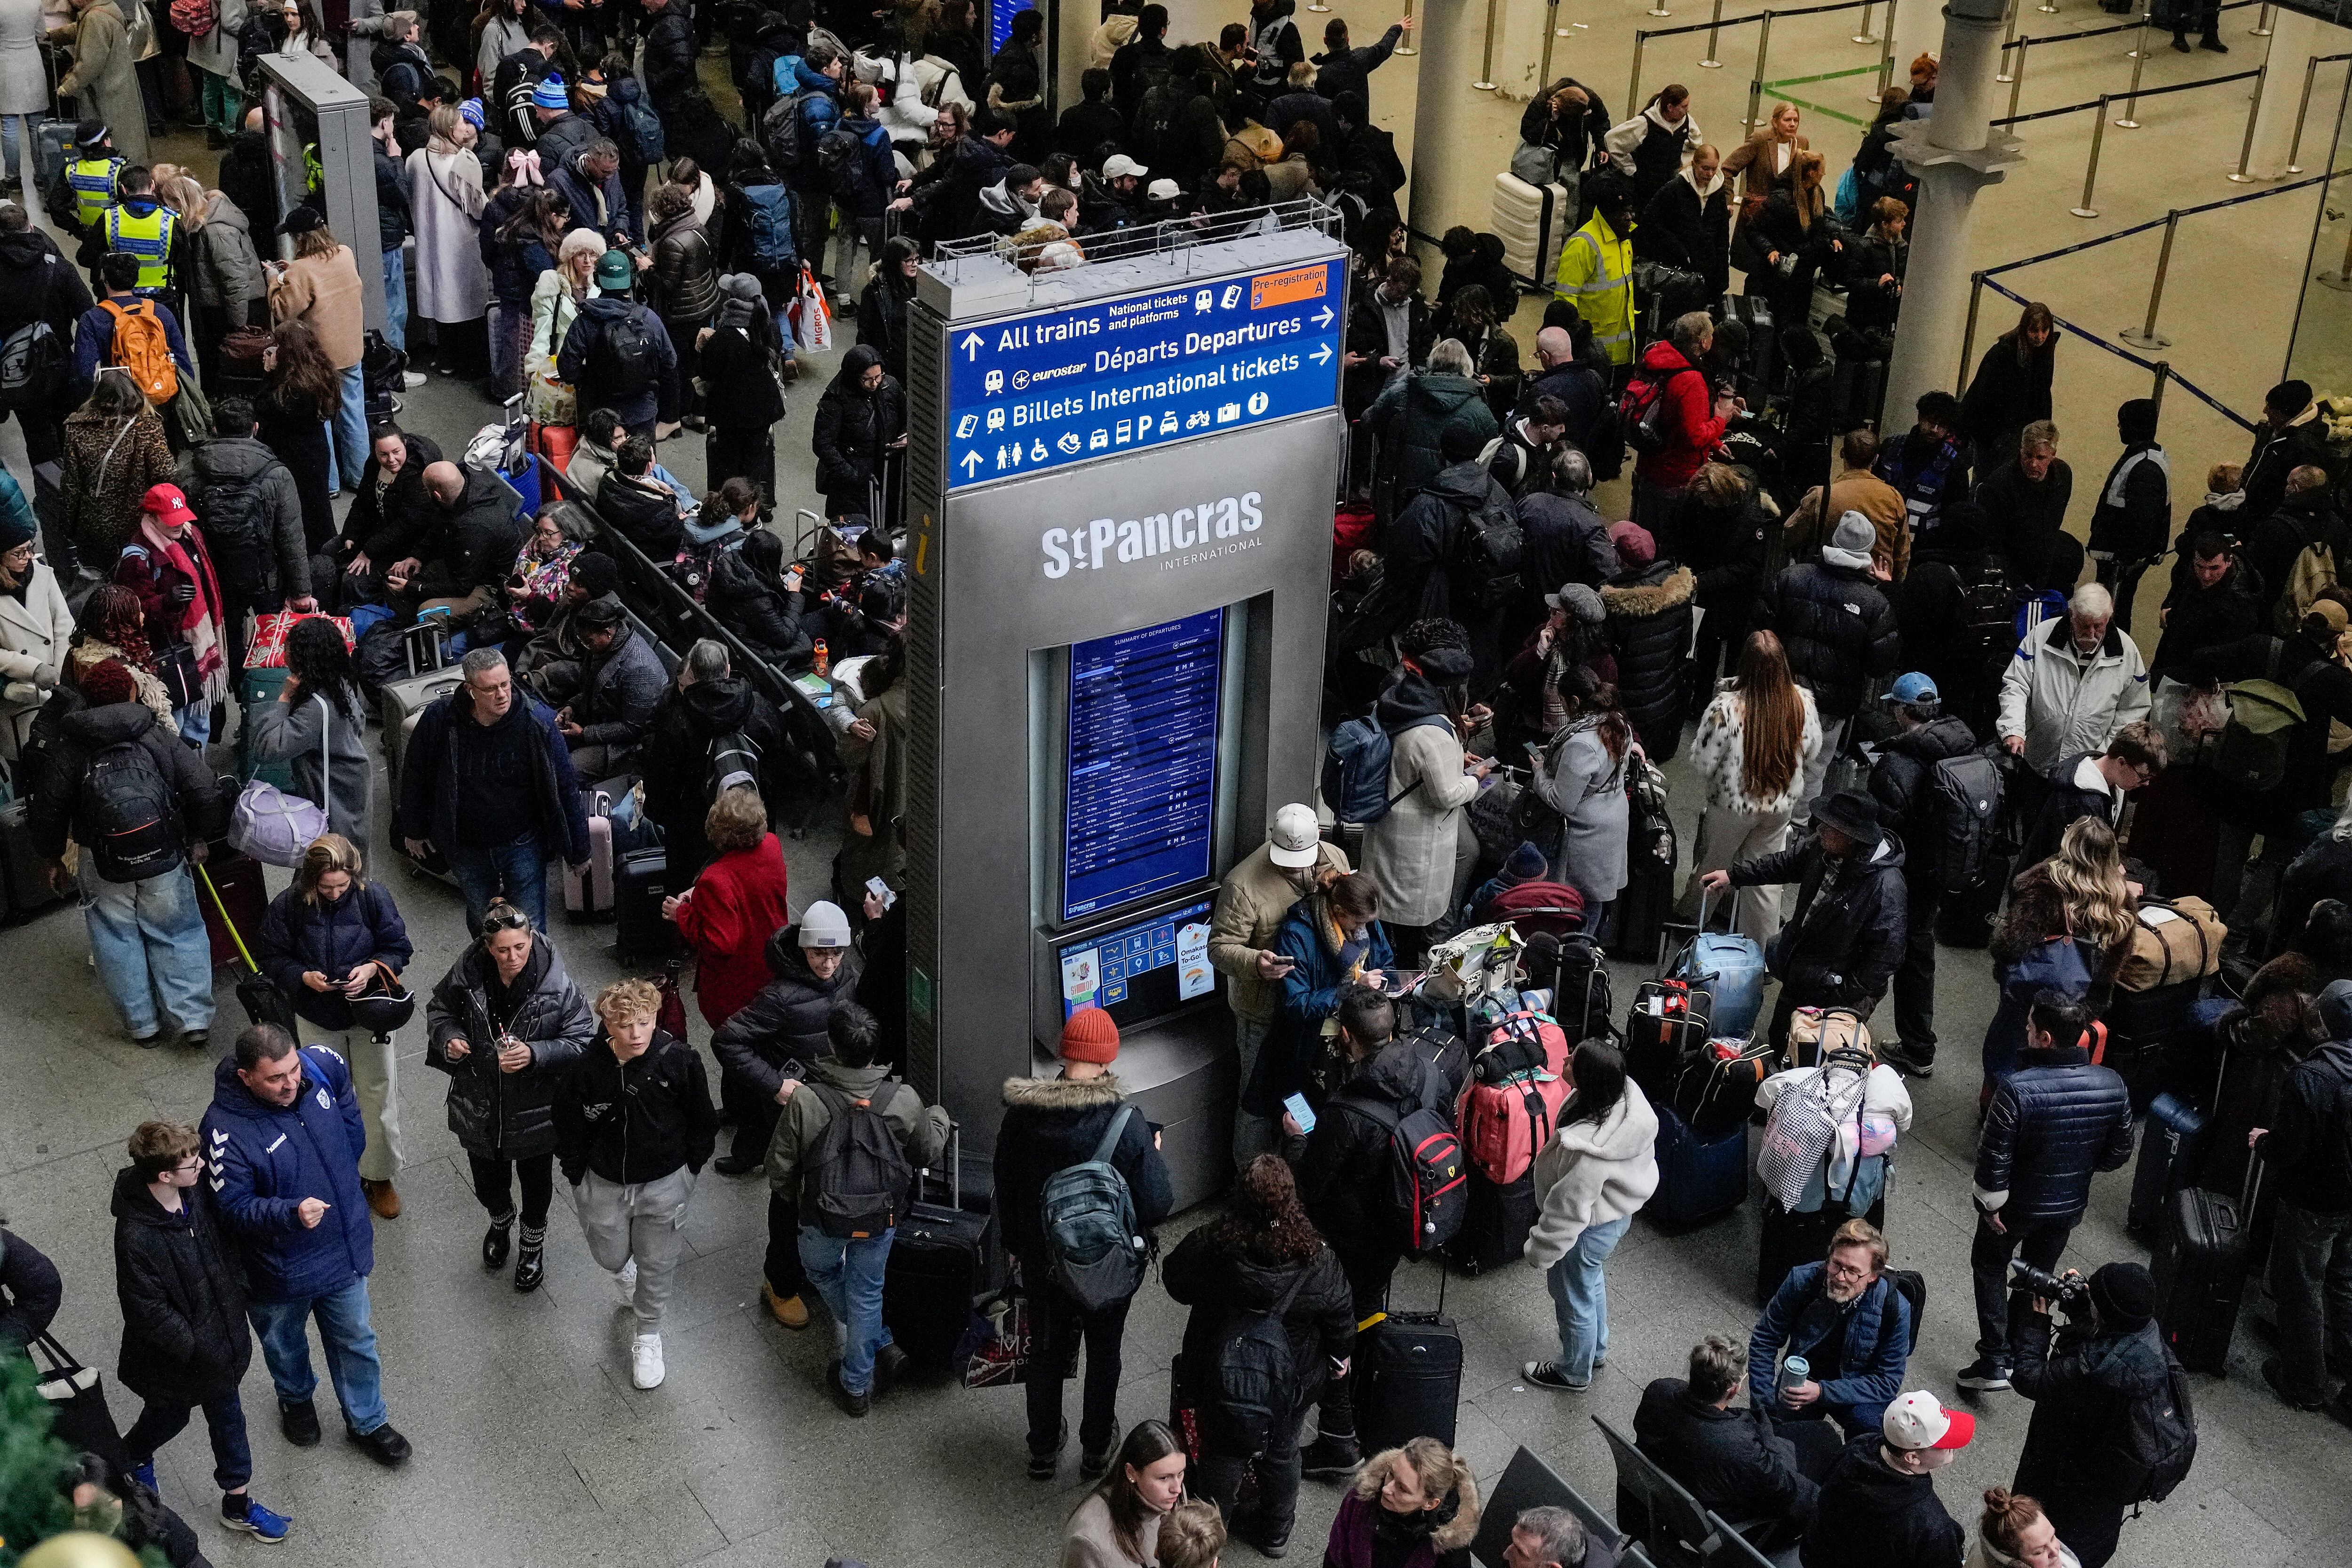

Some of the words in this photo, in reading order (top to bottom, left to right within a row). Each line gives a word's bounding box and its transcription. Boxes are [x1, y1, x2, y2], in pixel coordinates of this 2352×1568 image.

[1253, 269, 1325, 291] Pre-registration
[1315, 281, 1324, 294] A
[1109, 300, 1152, 317] National
[1154, 293, 1188, 310] tickets
[813, 308, 823, 345] MIGROS
[1109, 316, 1127, 330] and
[1129, 308, 1179, 329] platforms
[998, 327, 1029, 352] All
[1036, 317, 1100, 344] trains
[1095, 340, 1178, 374] Départs
[1185, 317, 1301, 355] Departures
[1032, 362, 1087, 381] eurostar
[1013, 396, 1083, 427] Billets
[1091, 361, 1225, 411] International
[1232, 353, 1299, 382] tickets
[172, 497, 183, 509] NY
[1160, 538, 1262, 571] INTERNATIONAL
[1114, 634, 1139, 645] SUMMARY
[1149, 624, 1181, 636] DEPARTURES
[1182, 952, 1201, 964] To-Go!
[266, 1132, 287, 1154] hummel
